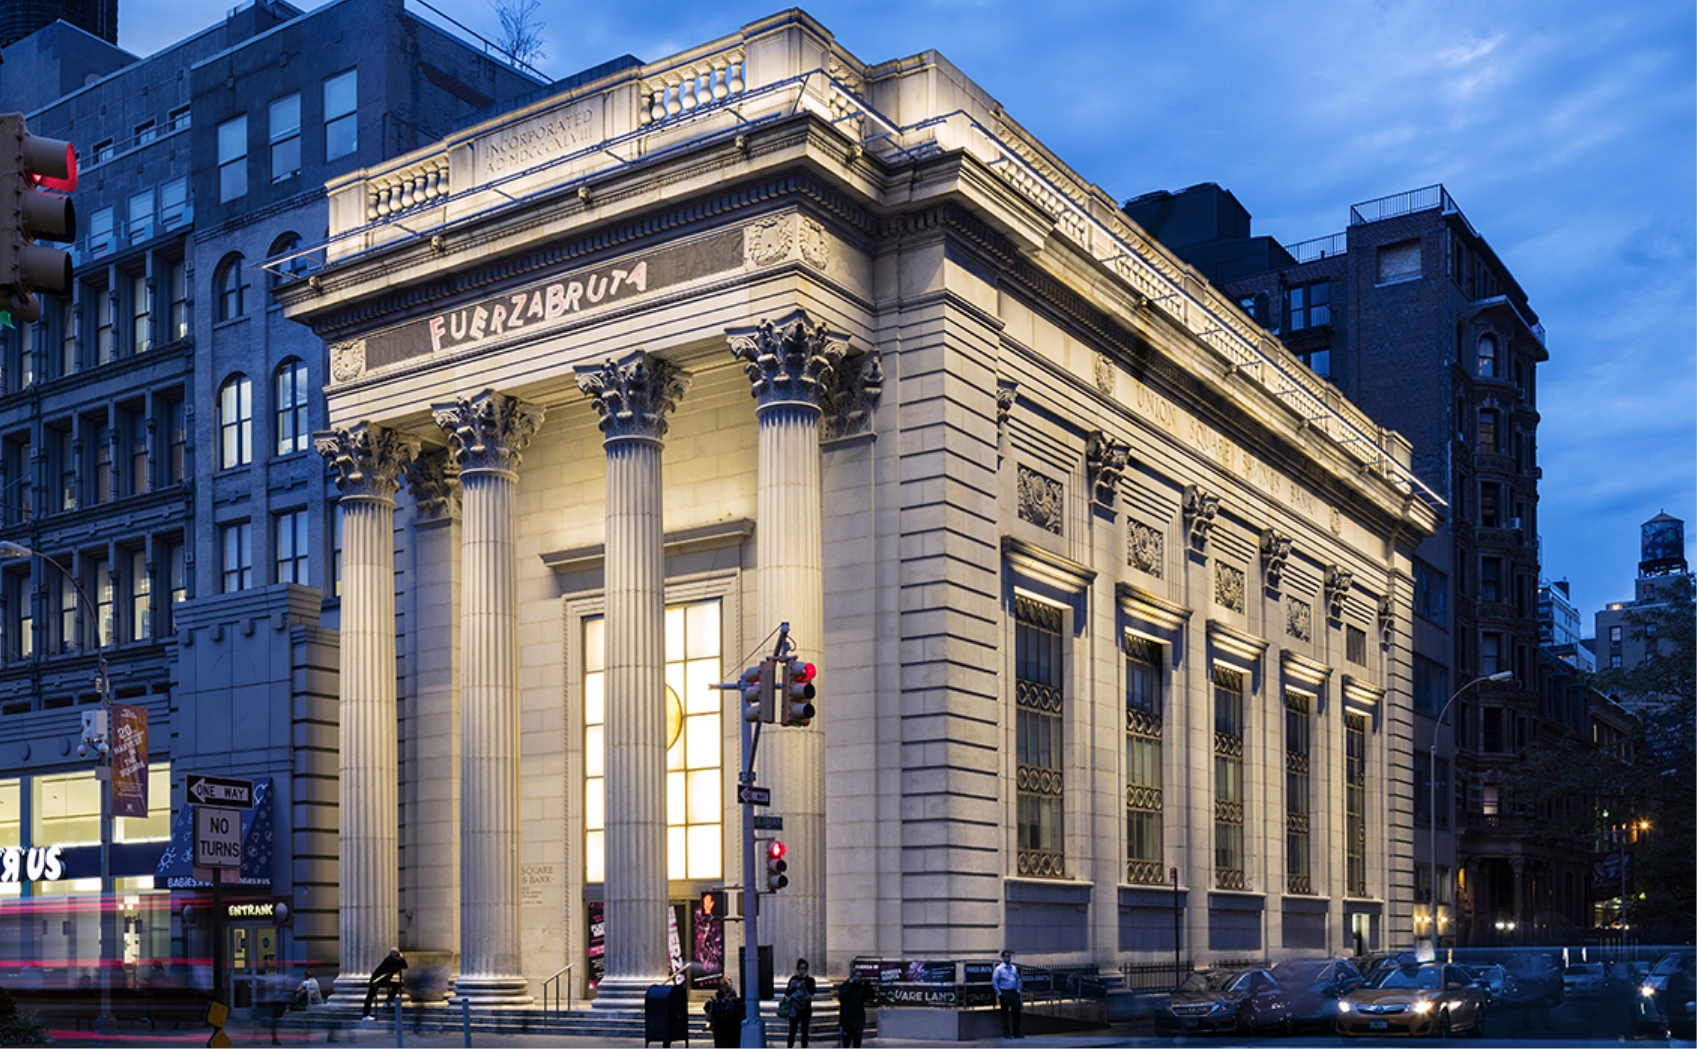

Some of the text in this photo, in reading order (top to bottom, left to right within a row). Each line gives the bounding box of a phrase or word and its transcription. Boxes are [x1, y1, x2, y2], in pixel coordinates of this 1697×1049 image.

[485, 108, 593, 159] INCORPORATED
[429, 261, 647, 351] FUERZABRUTA
[1135, 384, 1176, 427] UNION
[1189, 420, 1230, 463] SQUARE
[196, 783, 245, 799] ONE WAY
[210, 817, 230, 835] NO
[200, 840, 240, 858] TURNS
[26, 845, 62, 881] US
[228, 903, 274, 917] ENTRANC
